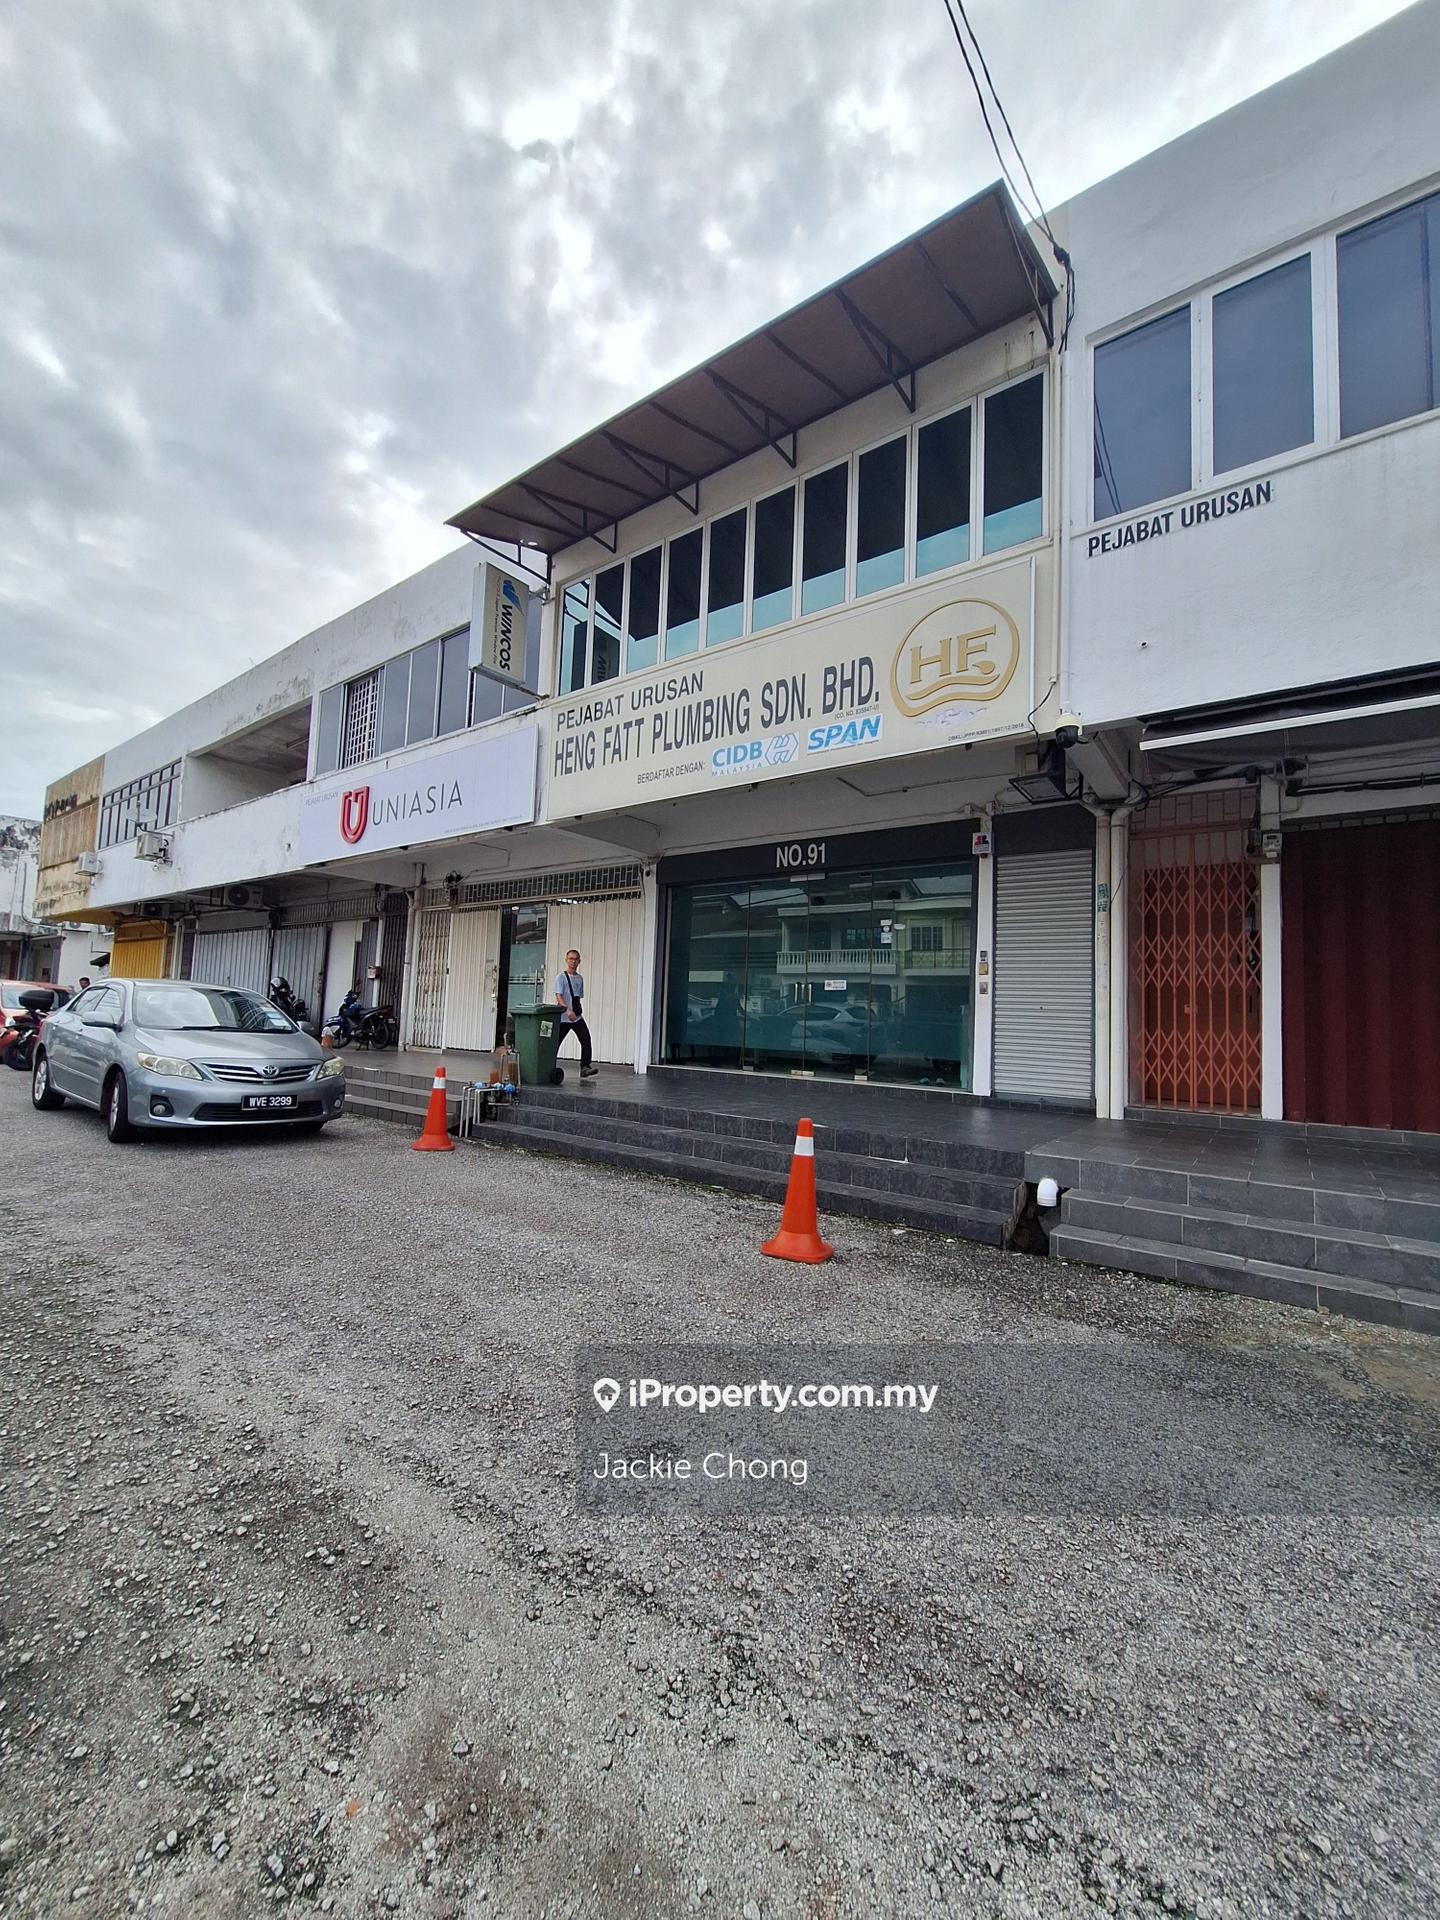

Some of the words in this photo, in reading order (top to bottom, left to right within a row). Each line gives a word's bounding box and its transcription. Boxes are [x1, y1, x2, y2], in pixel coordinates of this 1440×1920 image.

[1087, 511, 1174, 558] PEJABAT
[1181, 480, 1273, 528] URUSAN
[500, 604, 513, 671] WINCOS
[553, 728, 596, 777] HENG
[602, 718, 645, 767] FATT
[652, 688, 750, 753] PLUMBING
[760, 675, 812, 729] SDN.
[822, 655, 880, 713] BHD.
[556, 694, 625, 732] PEJABAT
[631, 670, 704, 711] URUSAN
[808, 714, 881, 751] SPAN
[637, 765, 675, 785] BERDAFTAR
[675, 760, 706, 780] DENGAN:
[712, 740, 763, 768] CIDB
[712, 761, 763, 777] MALAYSIA
[371, 779, 463, 827] UNIASIA
[775, 842, 827, 869] NO.91
[249, 1096, 267, 1107] WVE
[269, 1096, 292, 1106] 3299
